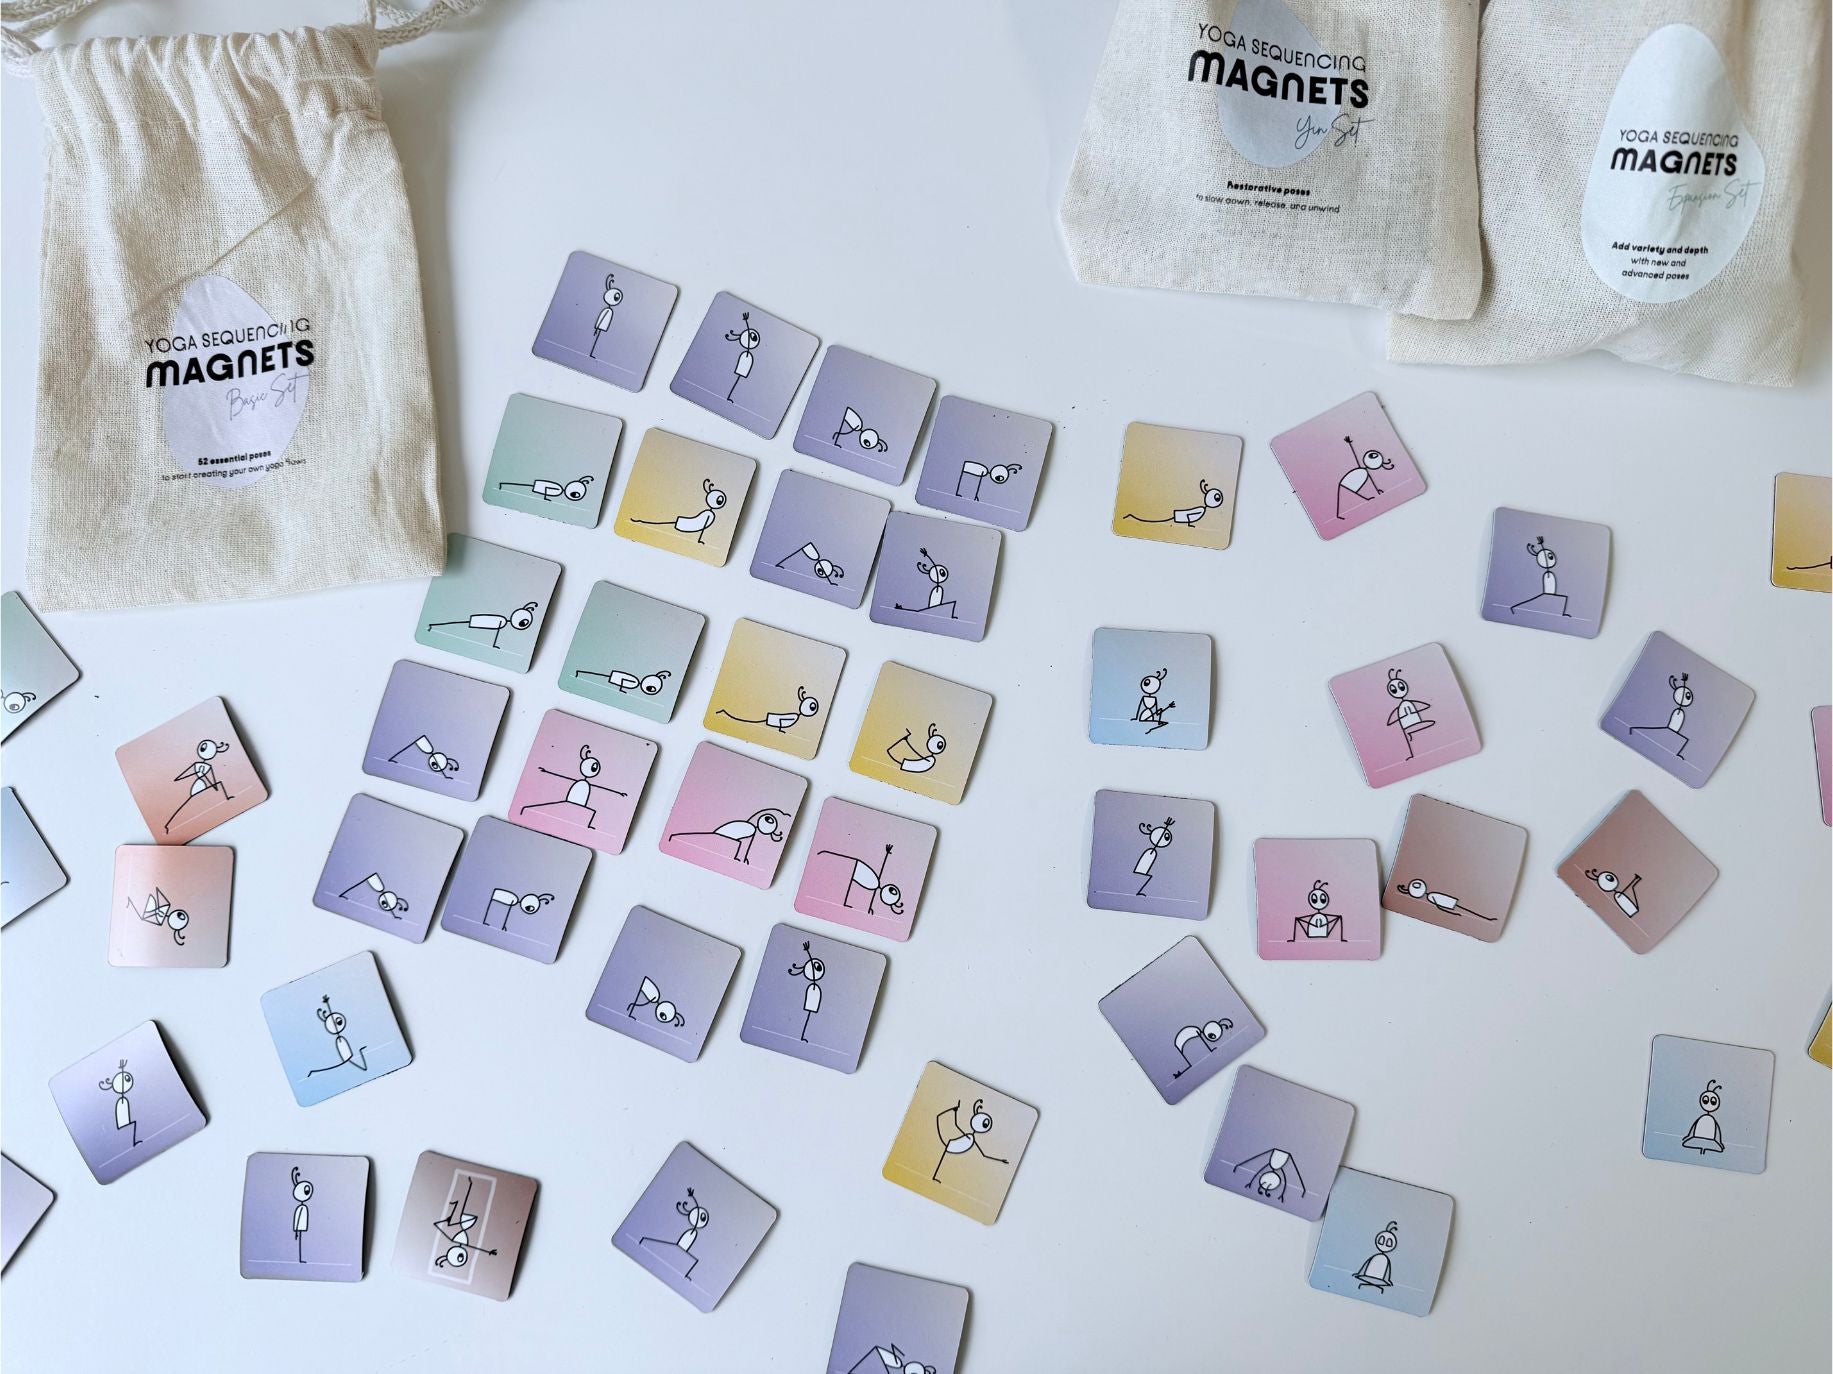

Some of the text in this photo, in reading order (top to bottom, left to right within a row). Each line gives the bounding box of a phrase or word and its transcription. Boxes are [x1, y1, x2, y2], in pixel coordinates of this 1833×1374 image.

[1198, 23, 1366, 72] YOGA SEQUENCING
[1188, 50, 1369, 109] MAGNETS
[1294, 113, 1375, 150] Yin Set
[1619, 129, 1739, 148] YOGA SEQUENCING
[1610, 147, 1737, 176] MAGNETS
[1227, 181, 1311, 196] Restorative poses
[1723, 178, 1761, 209] Set
[1308, 204, 1341, 214] unwind
[1612, 241, 1709, 256] Add variety and depth
[1631, 257, 1687, 267] with new and
[1622, 269, 1690, 282] advanced poses
[145, 335, 198, 354] YOGA
[146, 339, 315, 388] MAGNETS
[226, 372, 312, 421] Basic Set
[198, 450, 272, 465] 52 essential poses
[193, 469, 228, 479] creating
[229, 467, 247, 477] your
[249, 464, 265, 474] own
[265, 461, 285, 472] yoga
